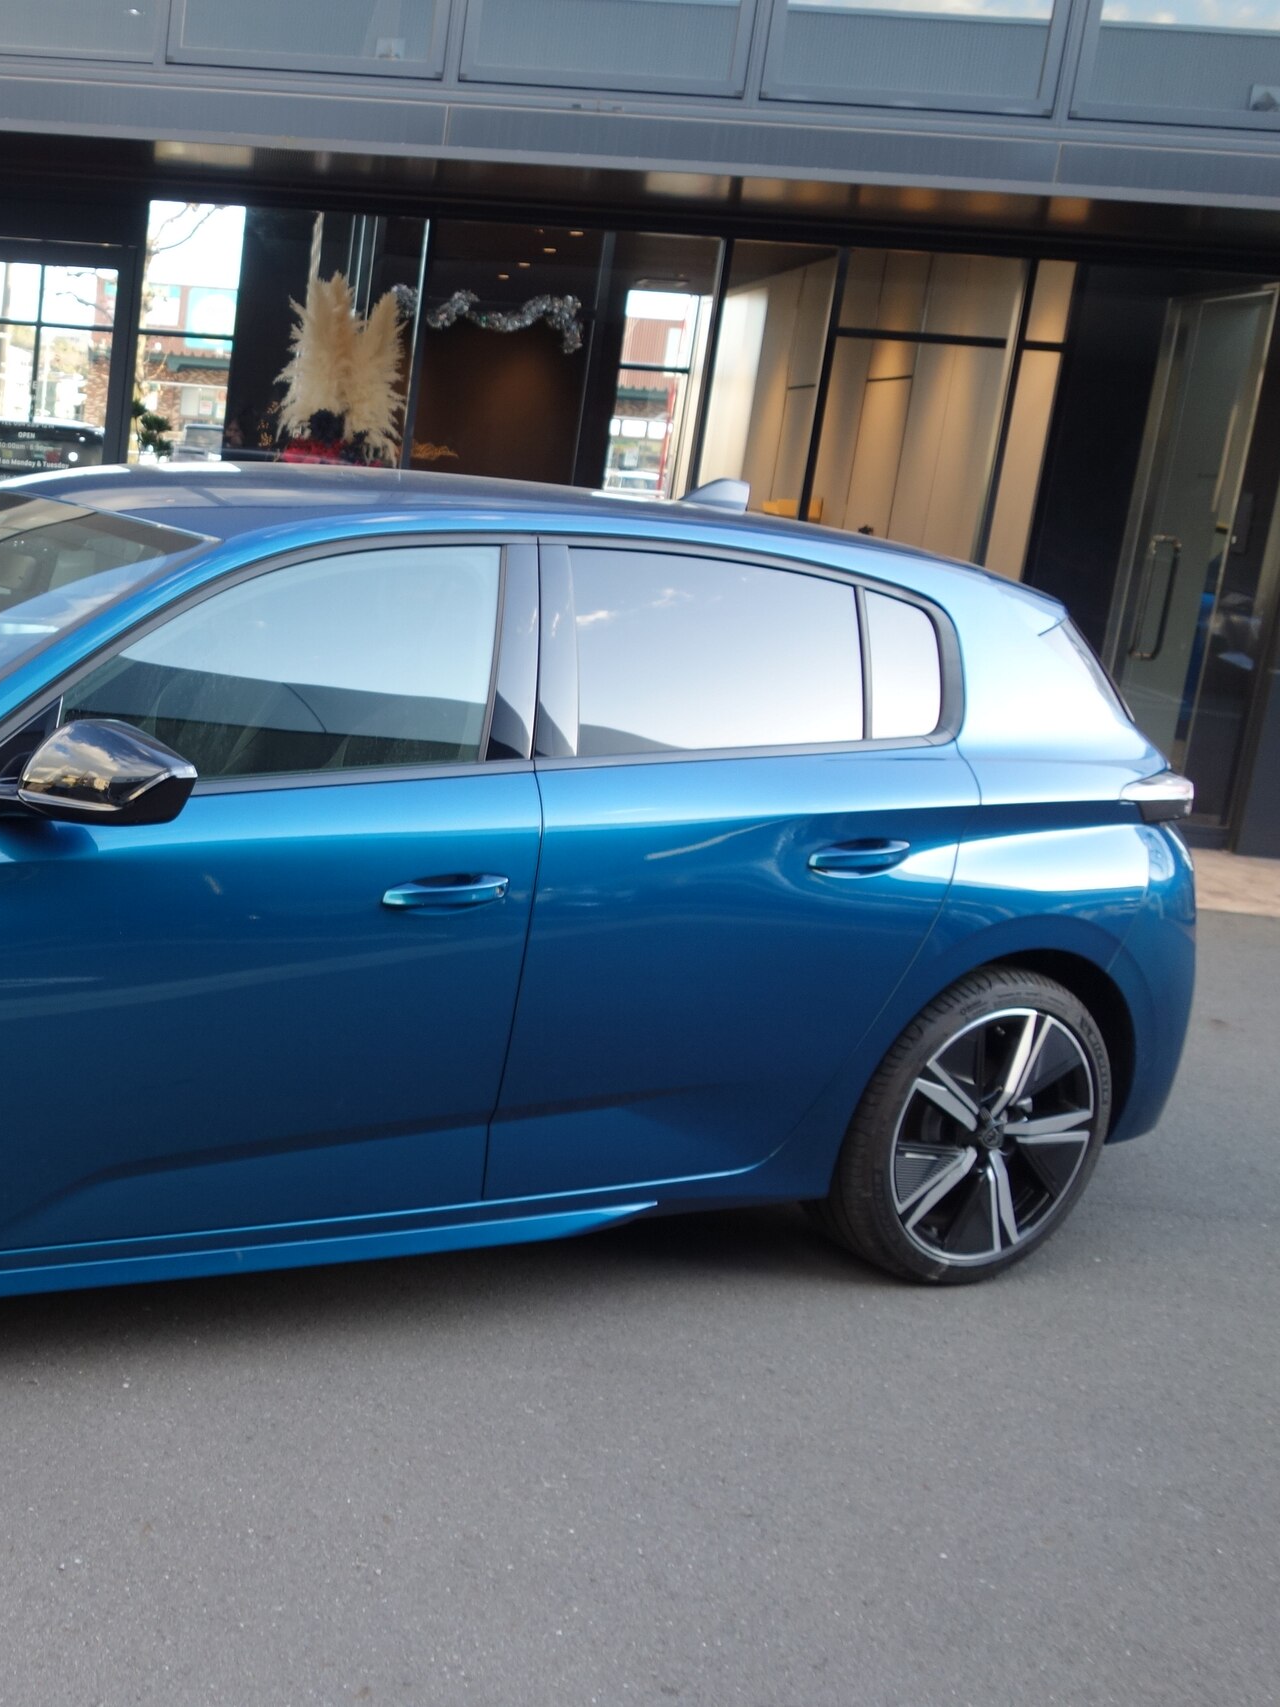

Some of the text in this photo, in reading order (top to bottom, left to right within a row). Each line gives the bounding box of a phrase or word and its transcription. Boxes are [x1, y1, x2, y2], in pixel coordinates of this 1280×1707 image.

[17, 431, 36, 439] OPEN
[11, 458, 35, 468] Monday
[43, 461, 70, 470] Tuesday
